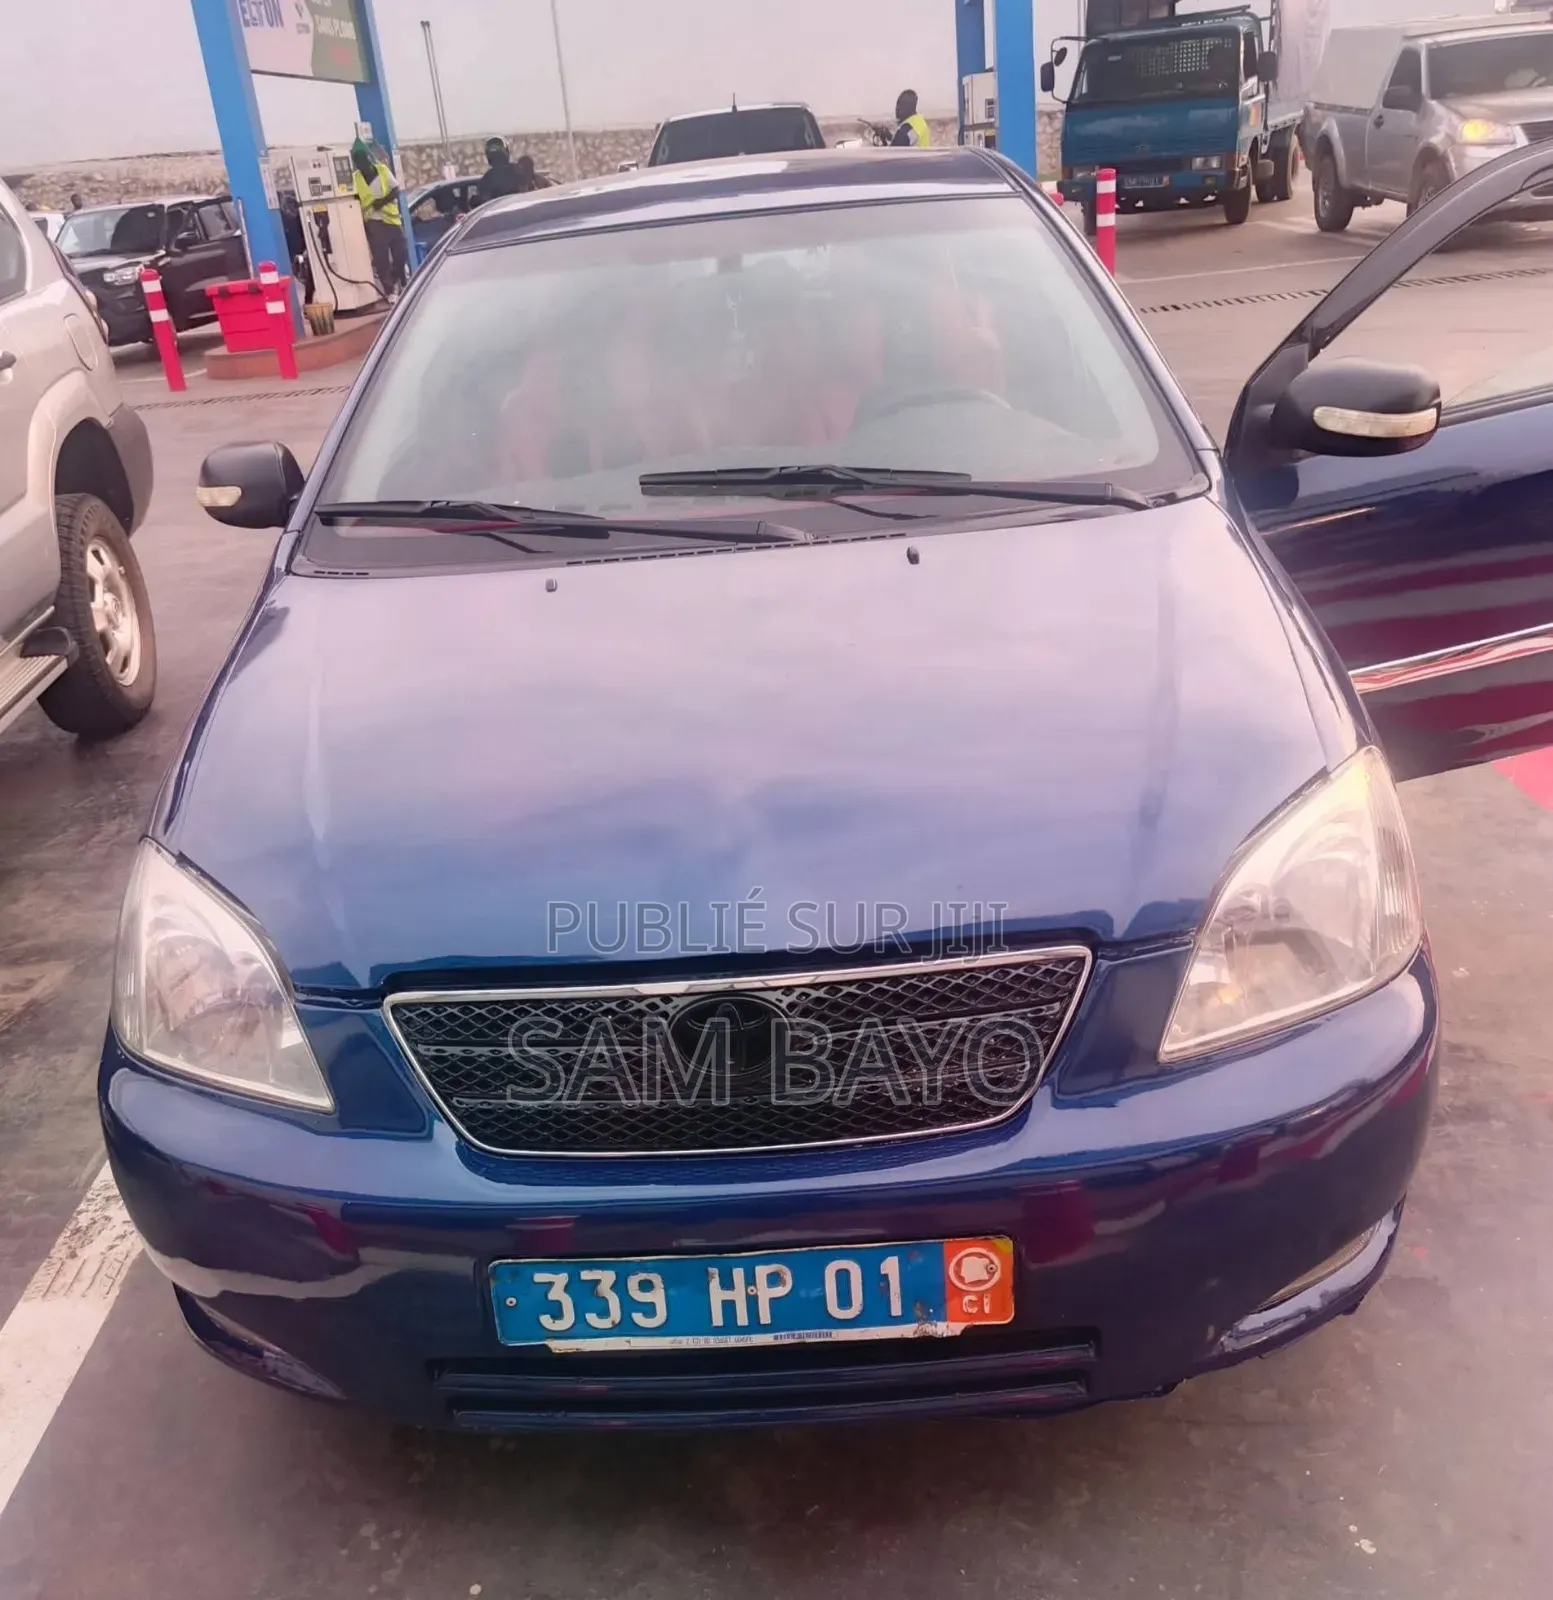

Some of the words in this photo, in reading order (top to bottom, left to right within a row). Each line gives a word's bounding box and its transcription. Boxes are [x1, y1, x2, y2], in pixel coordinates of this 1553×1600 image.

[533, 1269, 668, 1332] 339
[707, 1264, 793, 1328] HP
[824, 1255, 903, 1320] 01
